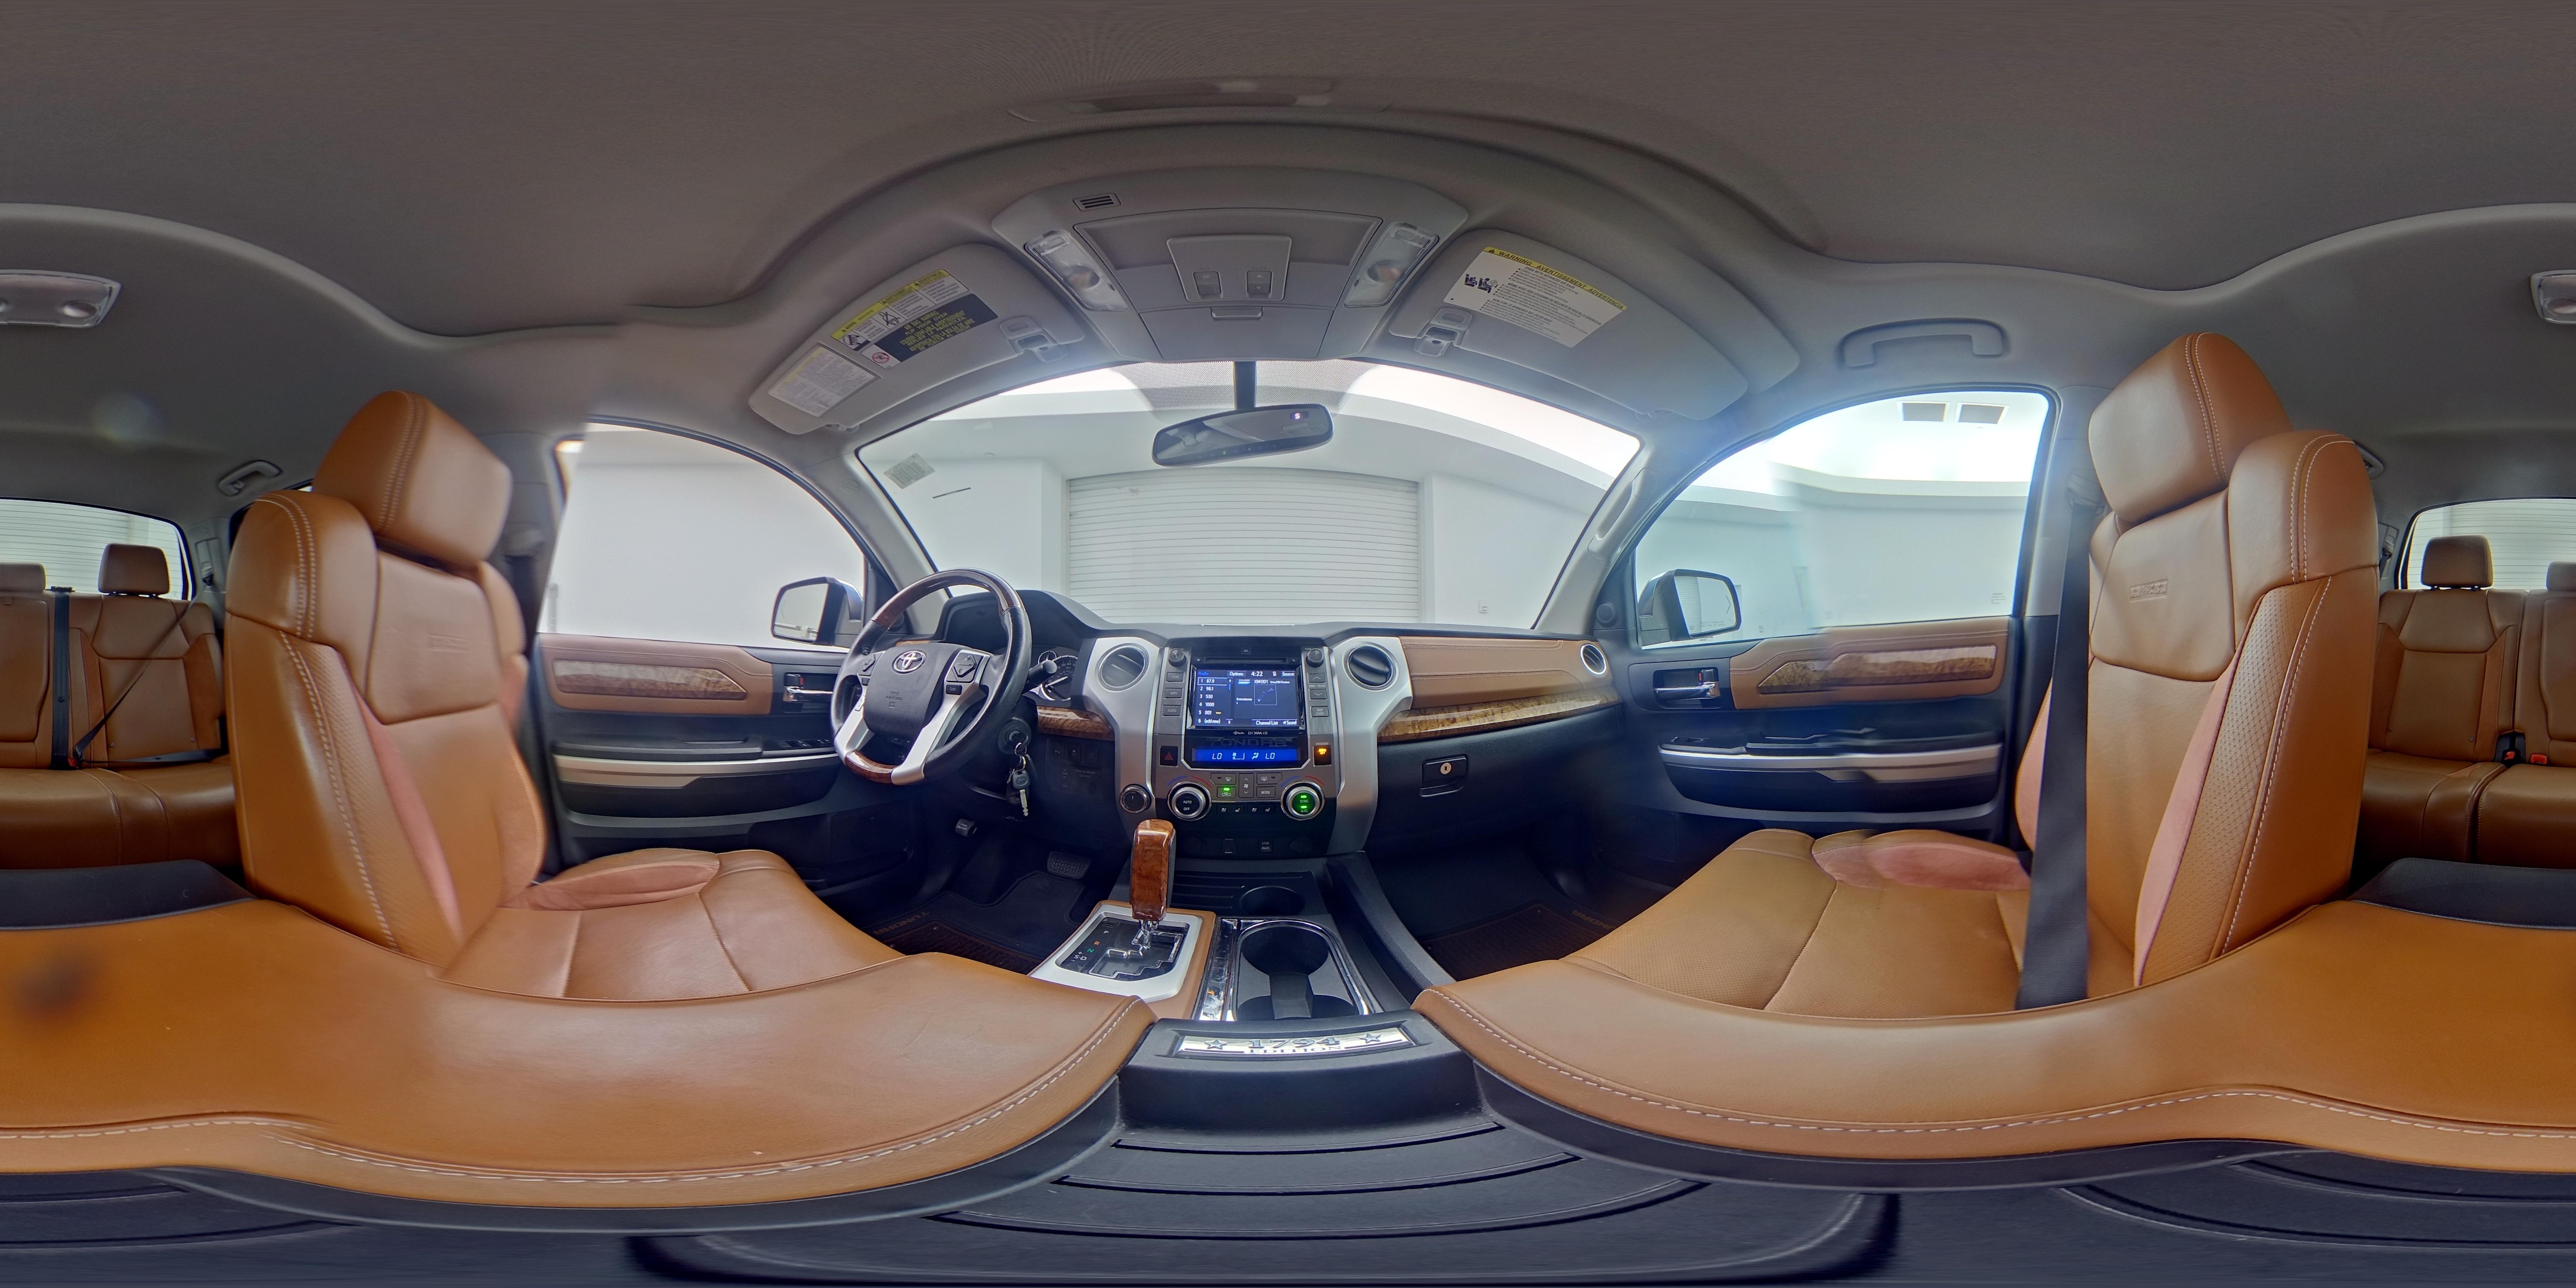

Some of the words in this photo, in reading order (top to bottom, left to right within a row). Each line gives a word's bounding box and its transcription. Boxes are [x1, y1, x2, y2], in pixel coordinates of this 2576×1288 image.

[1499, 251, 1533, 265] WARNING
[1536, 265, 1587, 289] AVERTISSEMENT
[1588, 289, 1623, 310] ADVERTENCIA
[917, 320, 931, 329] VISOR
[933, 312, 948, 321] OVER
[921, 310, 939, 321] WARNING
[955, 325, 971, 334] VISOR
[1249, 1036, 1342, 1049] 1794
[1249, 1045, 1342, 1054] EDITION
